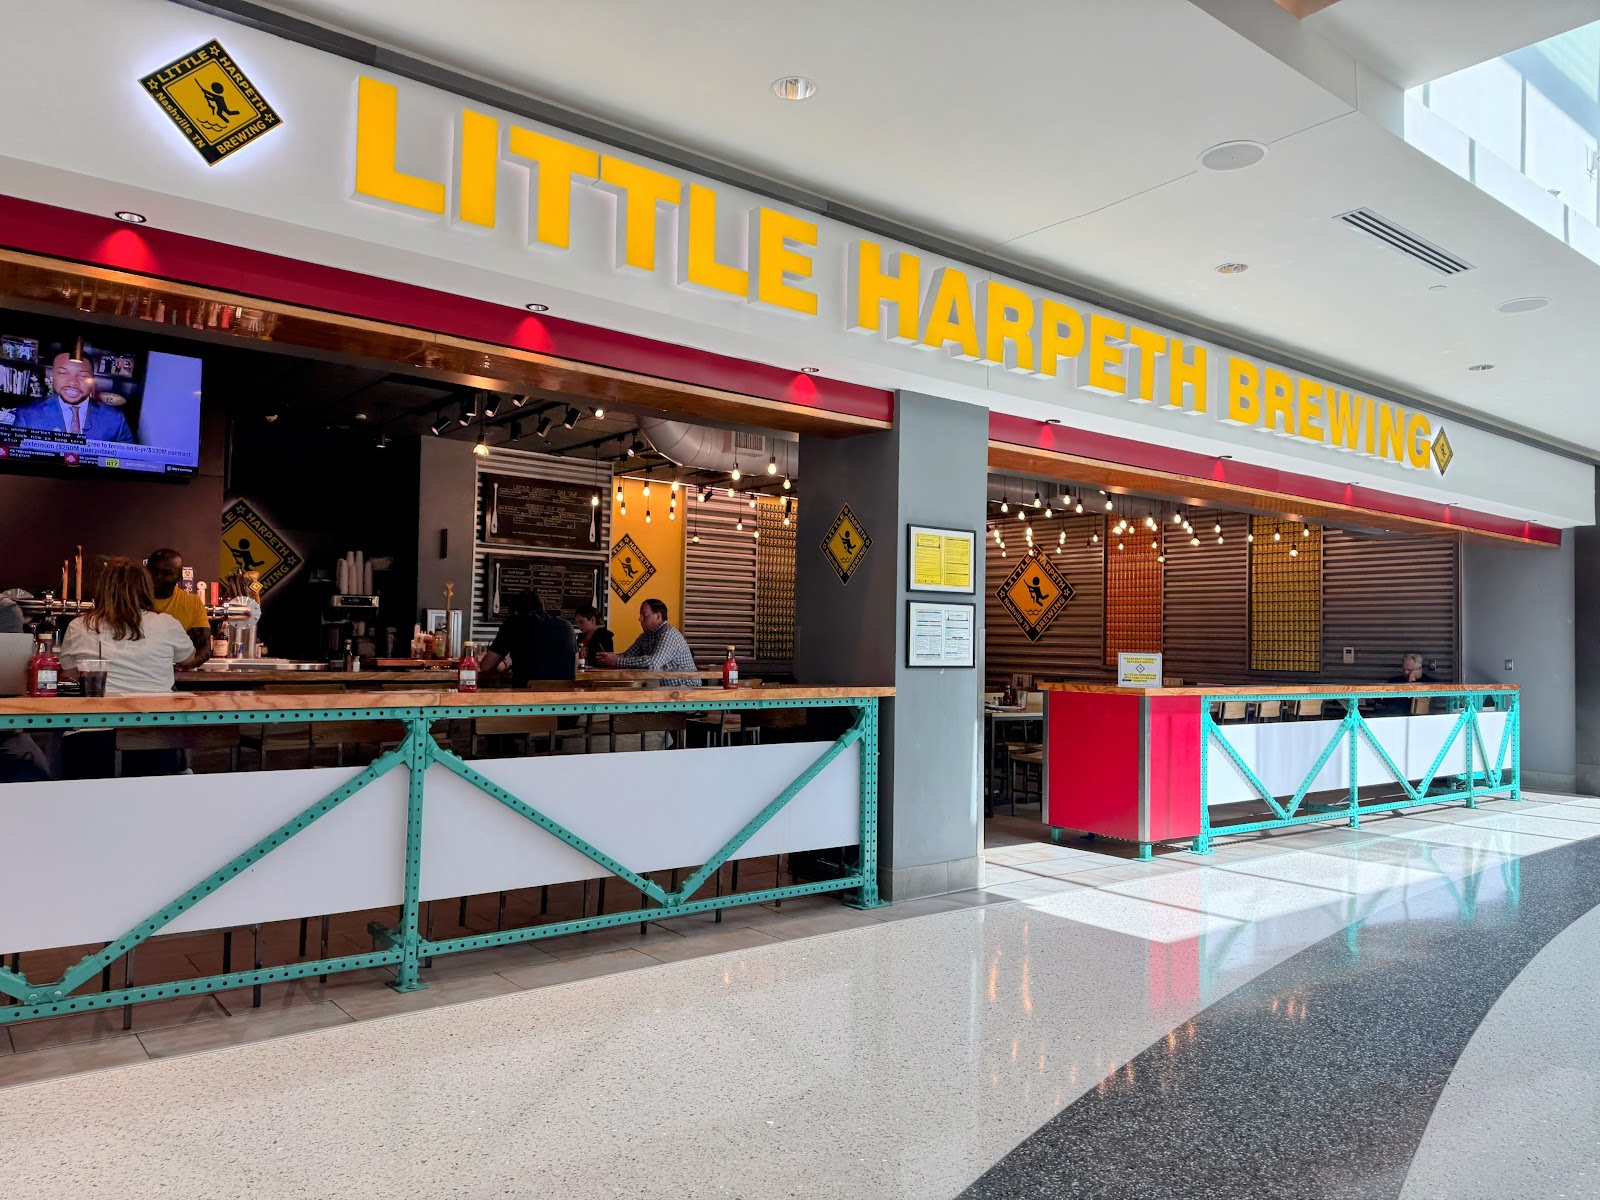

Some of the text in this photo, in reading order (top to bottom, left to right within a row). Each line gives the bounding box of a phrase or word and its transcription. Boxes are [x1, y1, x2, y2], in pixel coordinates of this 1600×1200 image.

[156, 50, 210, 84] LITTLE
[219, 56, 268, 112] HARPETH
[156, 92, 206, 149] Nashville TN
[216, 120, 267, 155] BREWING
[355, 75, 1432, 470] LITTLE HARPETH BREWING
[23, 441, 55, 449] extension
[81, 446, 118, 457] guaranteed)
[168, 450, 191, 458] contract
[245, 512, 290, 557] HARPETH
[825, 512, 845, 544] LITTLE
[847, 512, 868, 541] HARPETH
[611, 540, 625, 554] TLE
[628, 541, 651, 569] HARPETH
[846, 545, 868, 577] BREWING
[627, 572, 651, 598] BREWING
[1003, 555, 1032, 591] LITTLE
[1036, 554, 1066, 590] HARPETH
[1035, 597, 1066, 633] BREWING
